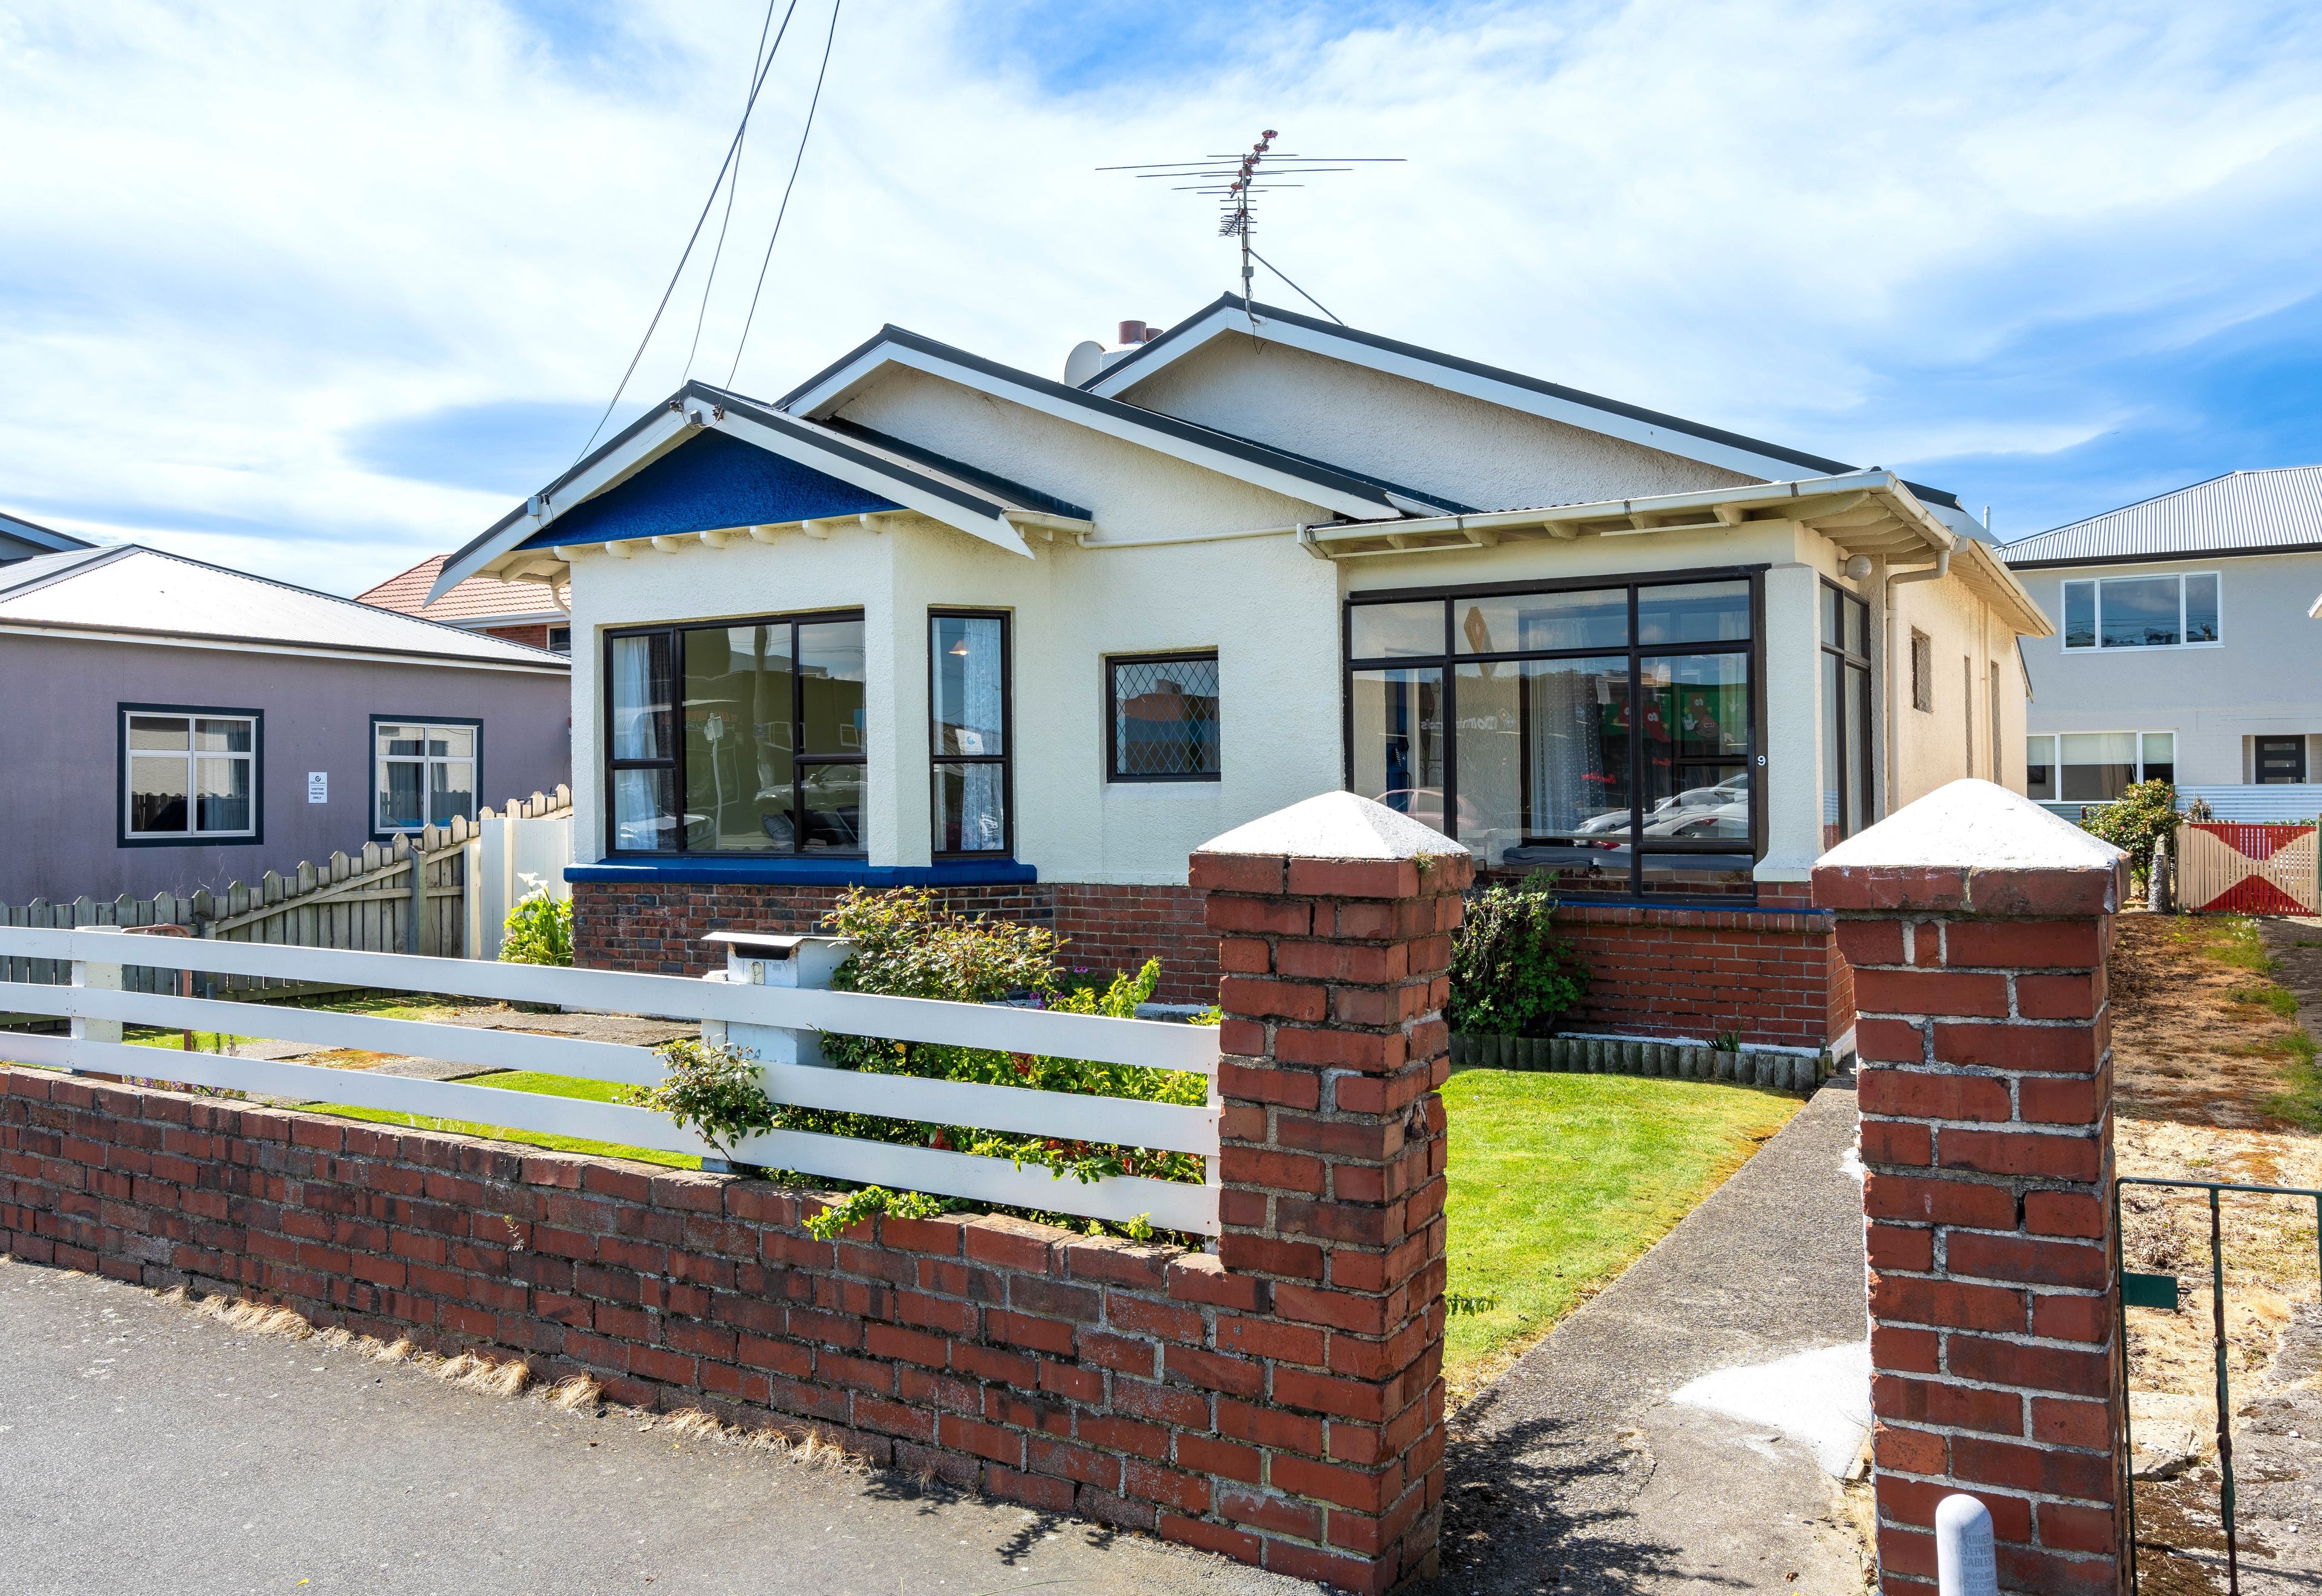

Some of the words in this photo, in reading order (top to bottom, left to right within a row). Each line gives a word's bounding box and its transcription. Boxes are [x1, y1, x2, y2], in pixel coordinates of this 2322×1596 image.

[1757, 755, 1766, 766] 9
[1961, 1556, 1992, 1567] CABLES
[1979, 1578, 1996, 1588] OFFIC
